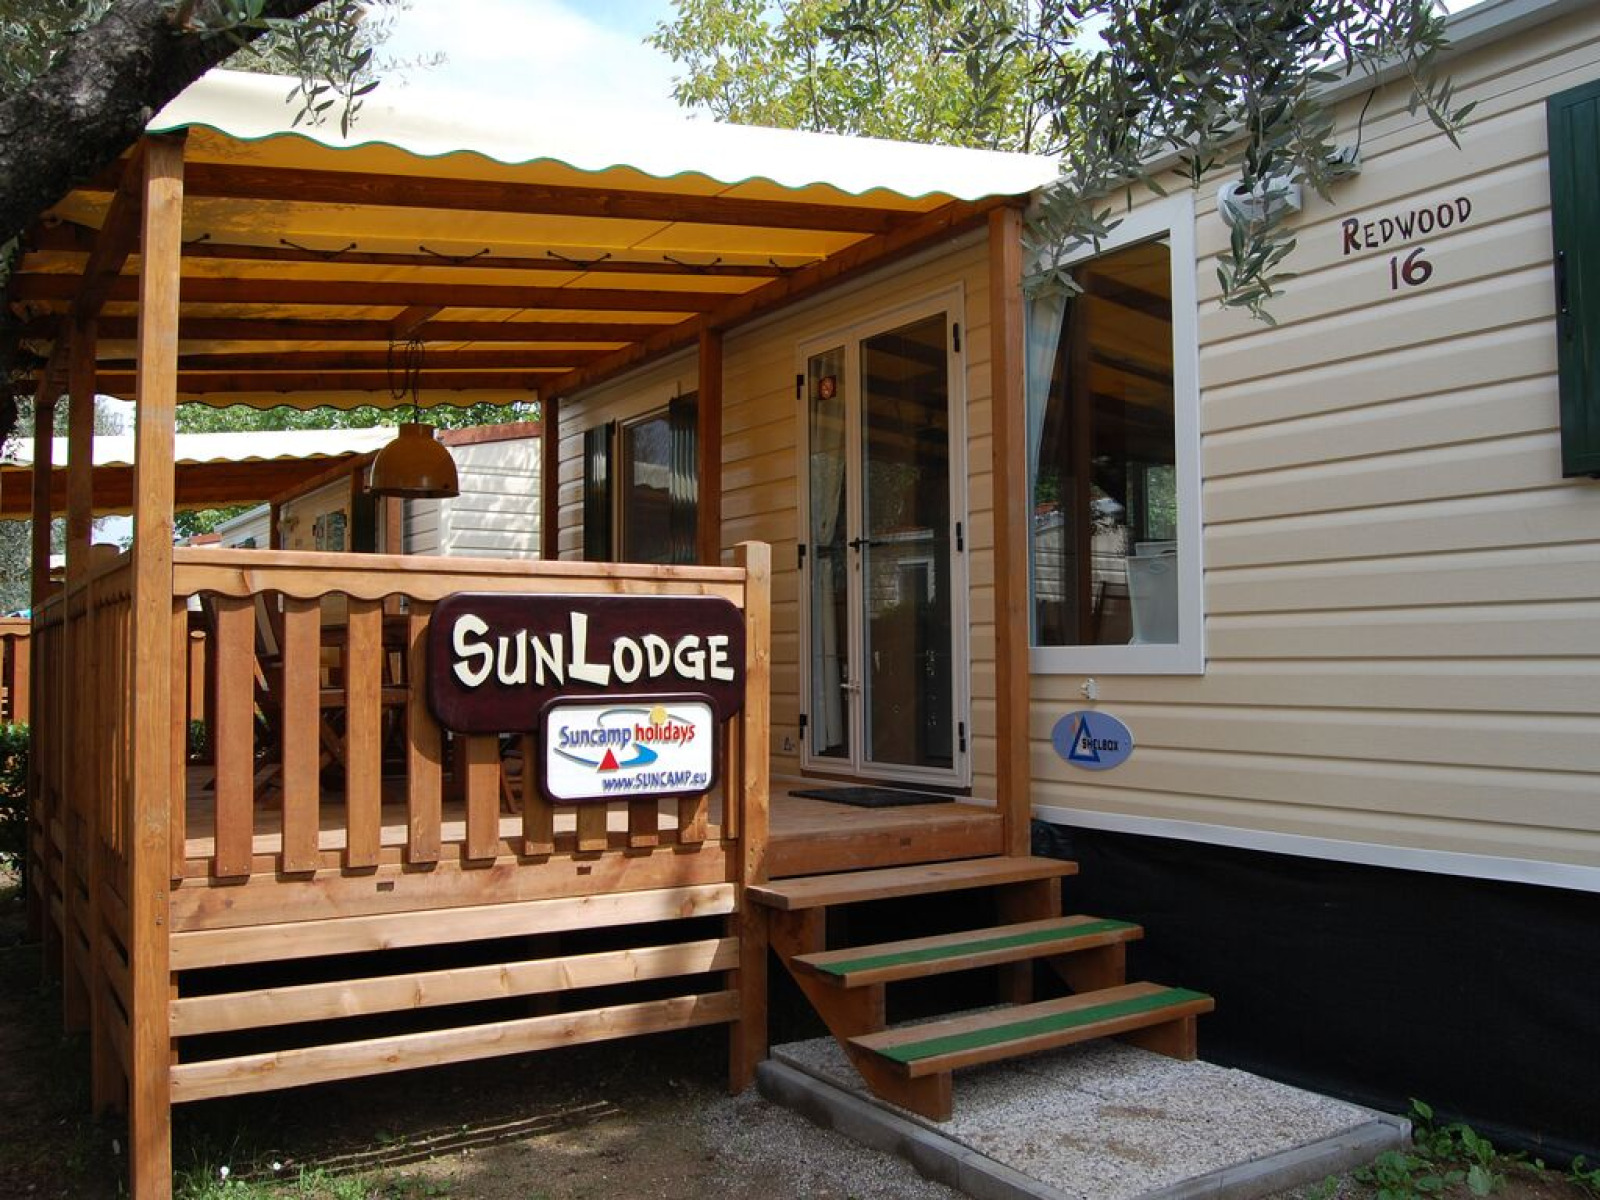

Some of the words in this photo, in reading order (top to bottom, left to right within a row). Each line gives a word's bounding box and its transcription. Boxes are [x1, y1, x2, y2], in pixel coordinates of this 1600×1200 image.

[1342, 197, 1472, 255] REDWOOD
[1390, 247, 1433, 289] 16
[559, 725, 632, 750] Suncamp
[634, 721, 696, 747] holidays
[1082, 738, 1118, 751] SHELBOX
[602, 770, 707, 792] www.SUNCAMP.eu
